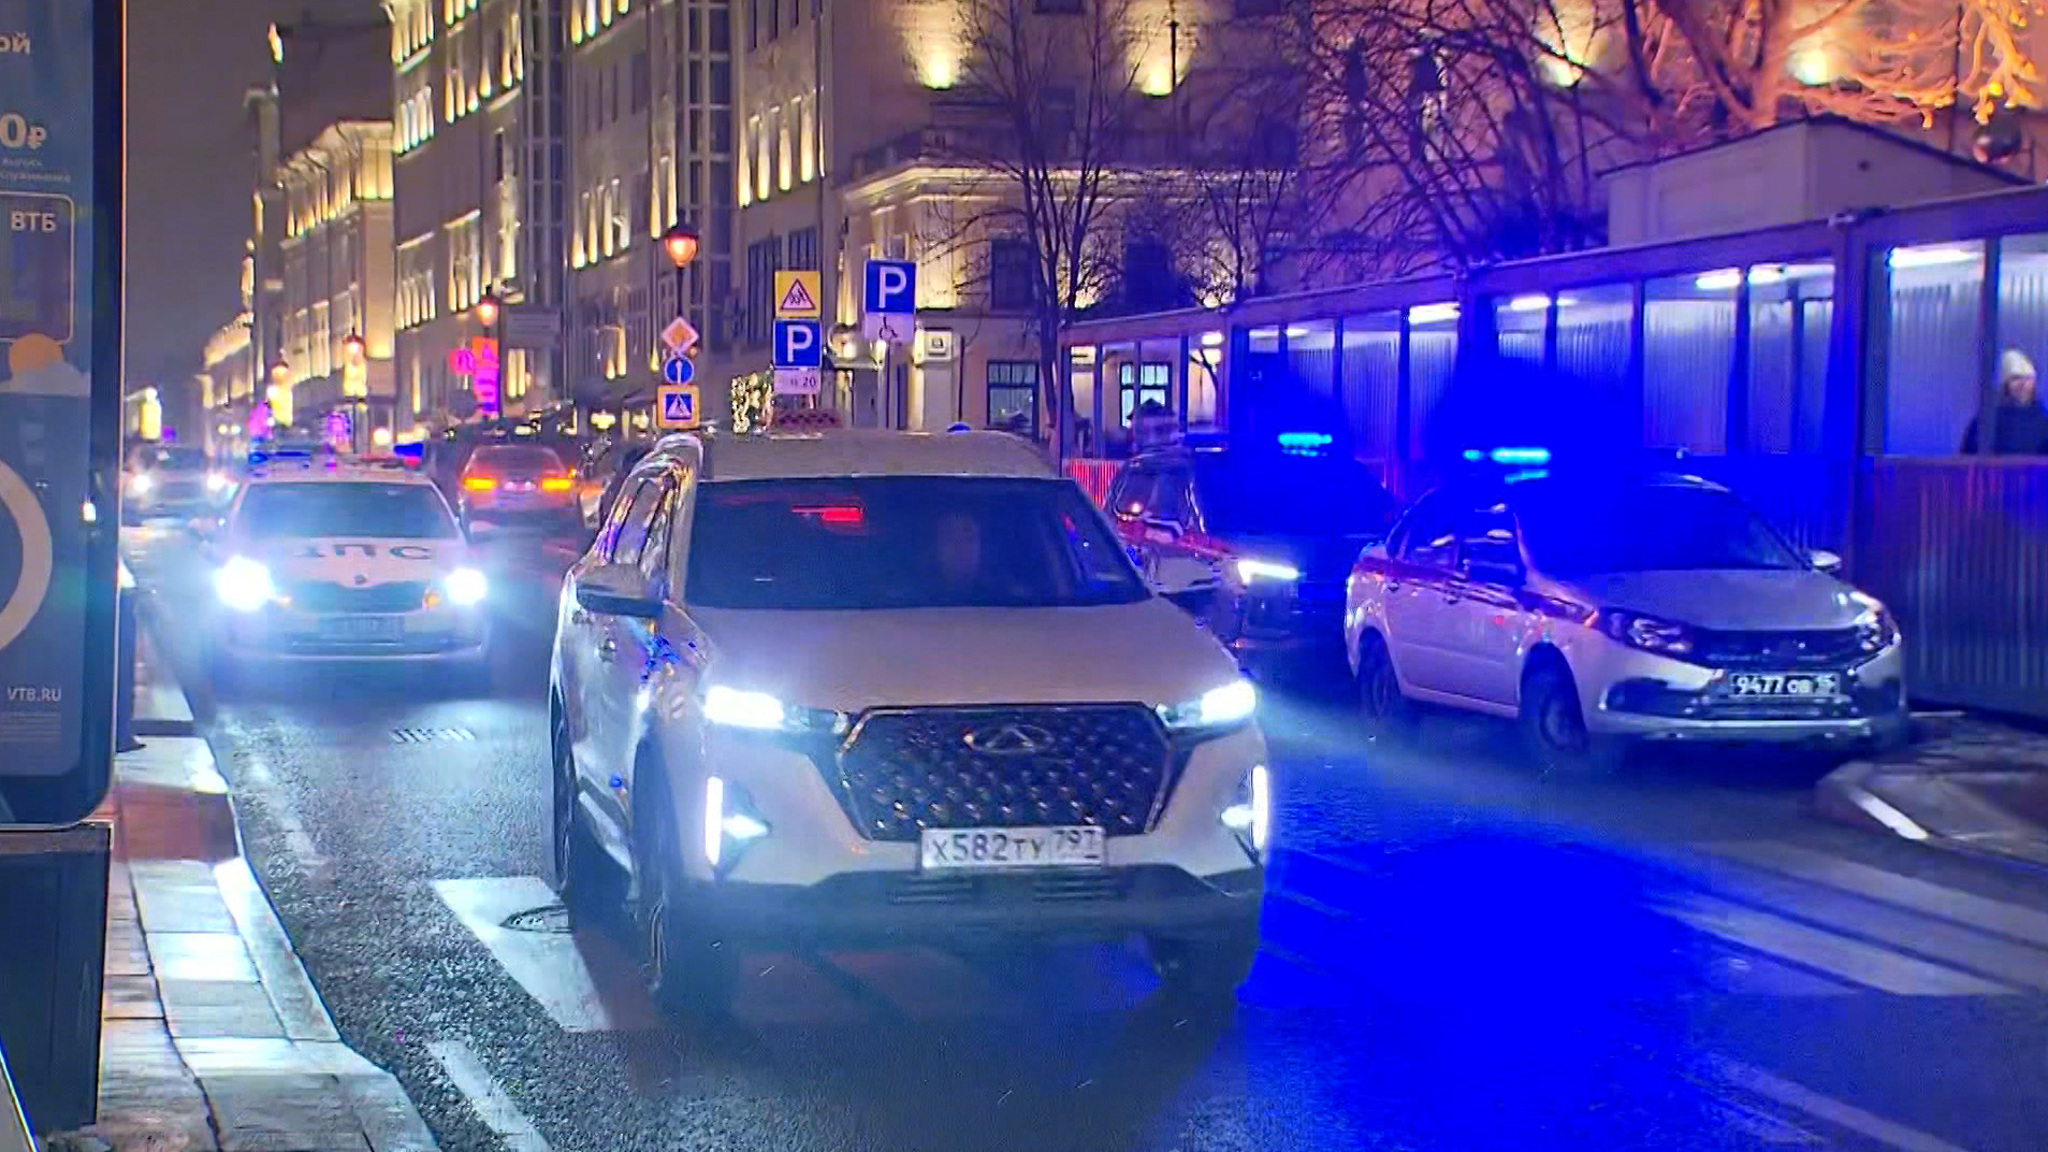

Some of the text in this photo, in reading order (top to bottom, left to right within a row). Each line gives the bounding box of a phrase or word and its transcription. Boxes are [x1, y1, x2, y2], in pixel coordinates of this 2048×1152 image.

[10, 210, 57, 232] ВТБ
[879, 266, 906, 308] P
[786, 325, 813, 363] P
[7, 688, 61, 702] VTB.RU
